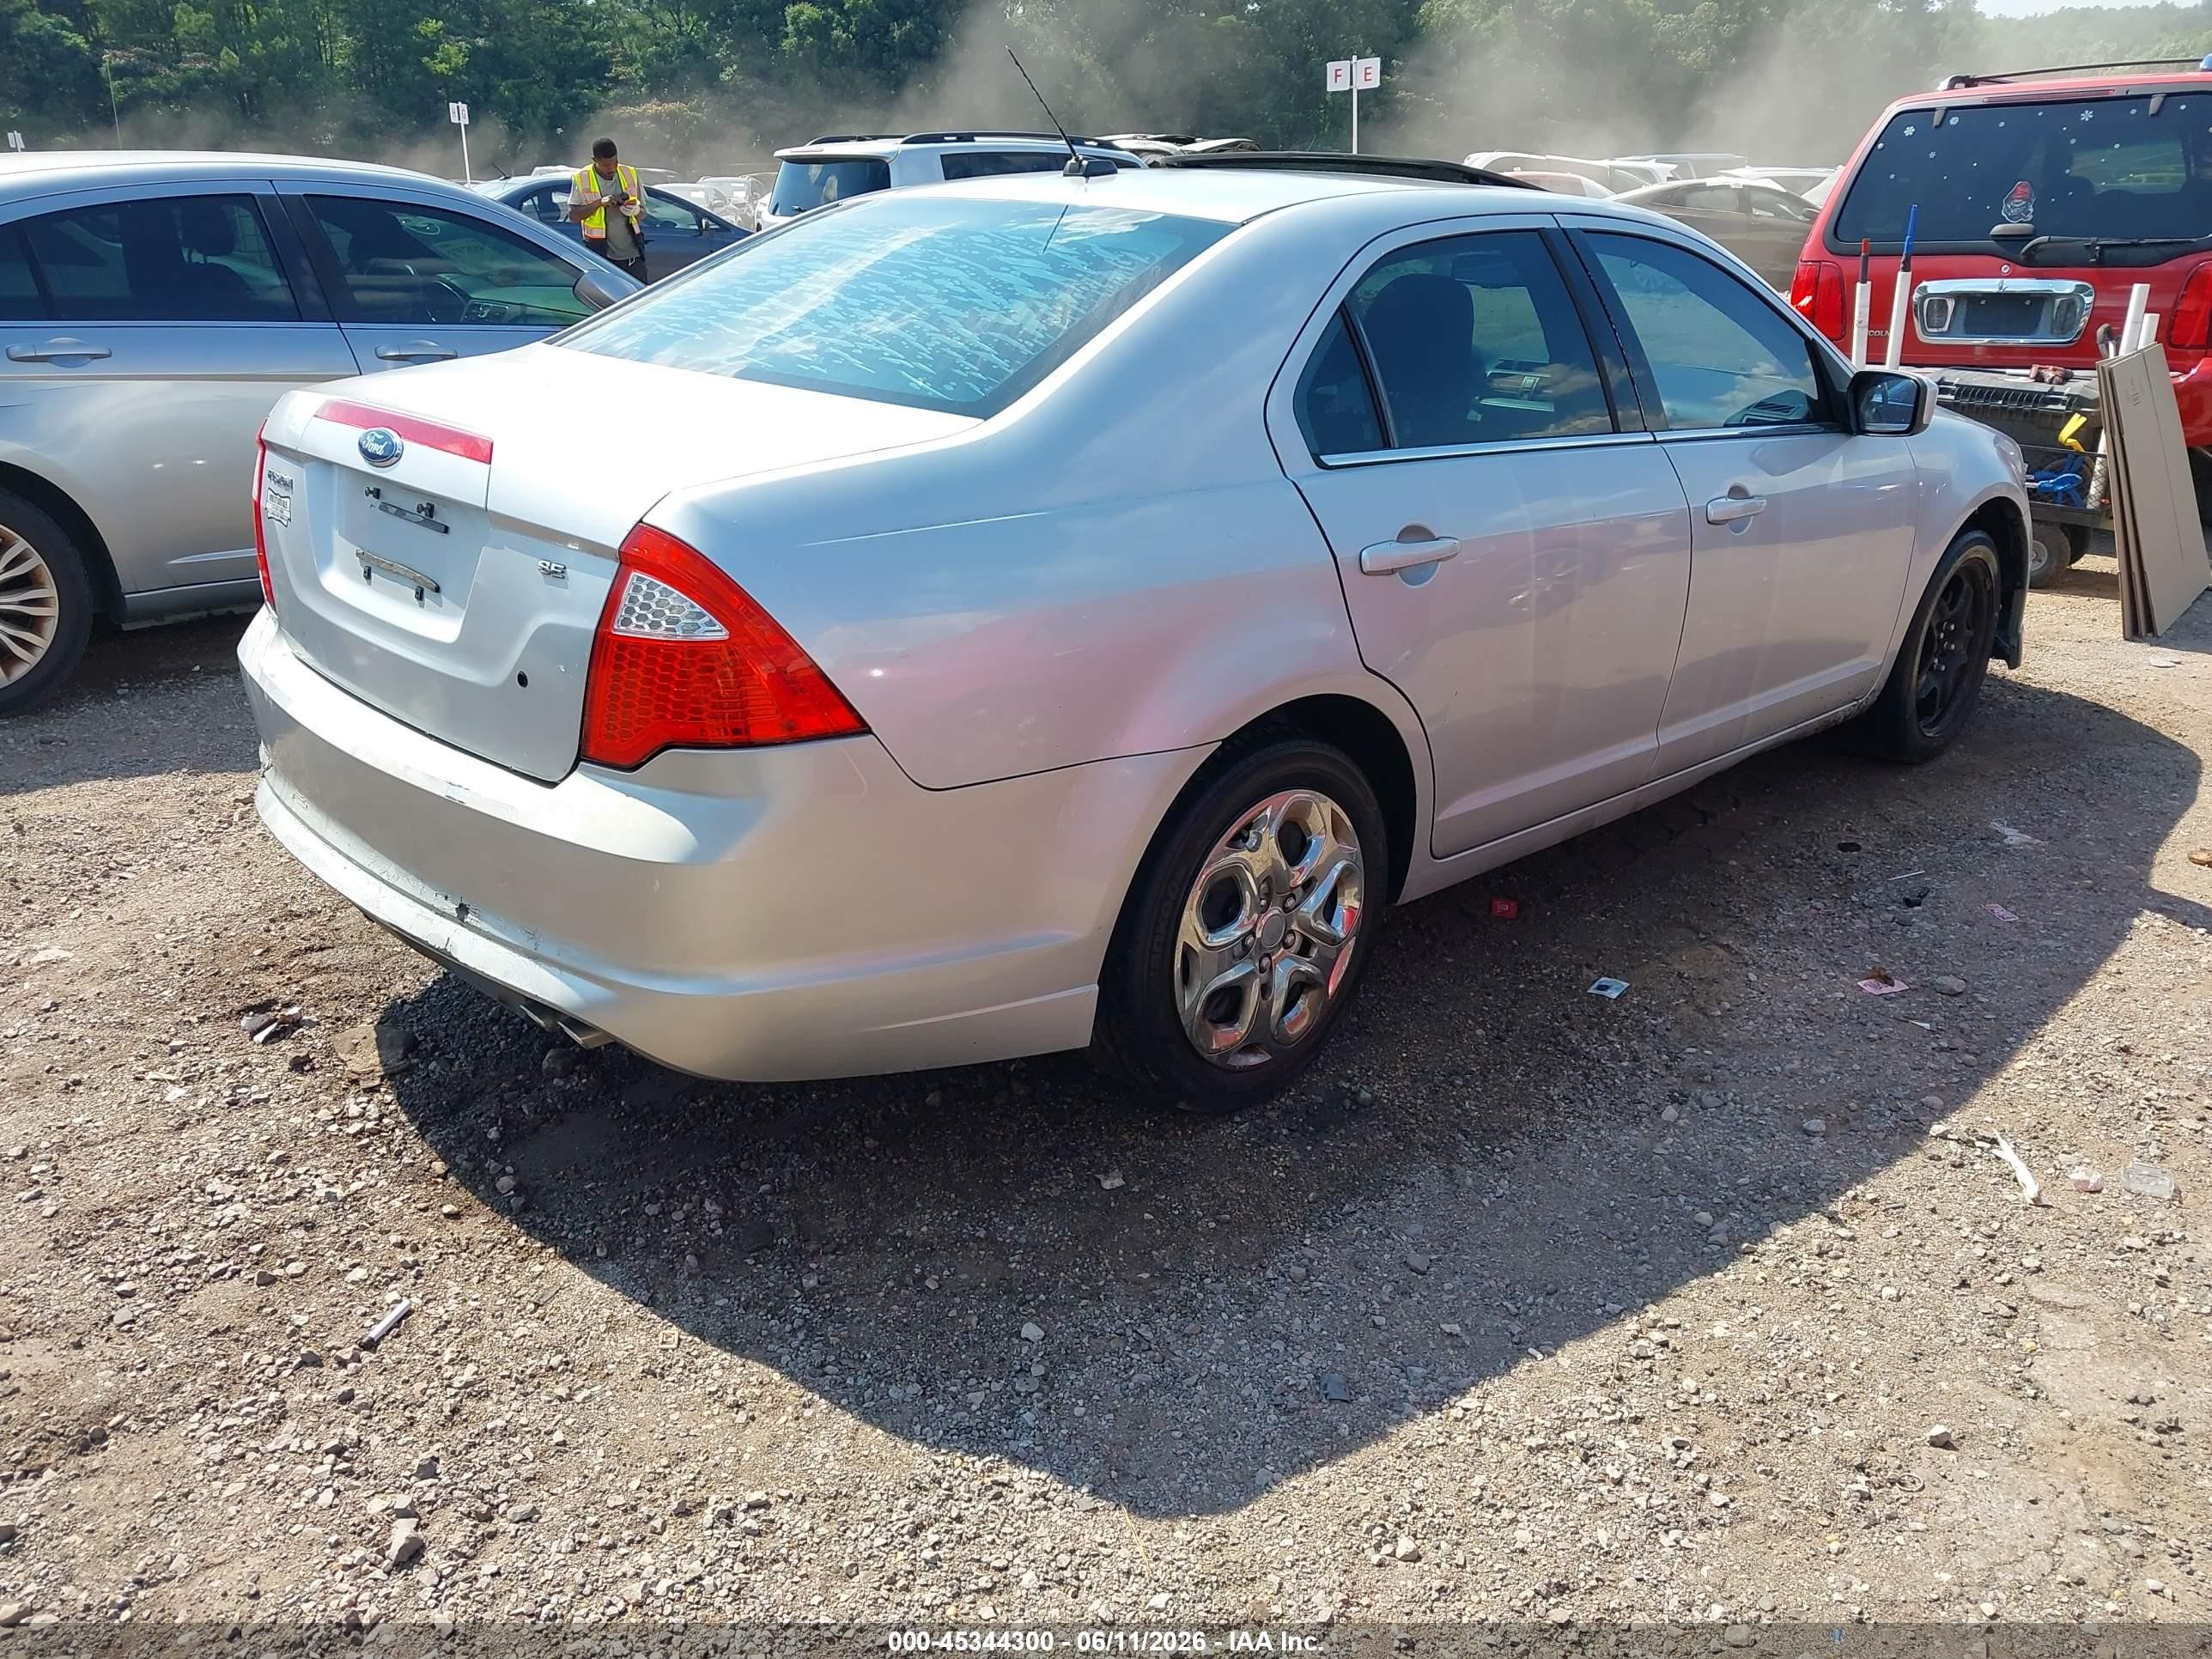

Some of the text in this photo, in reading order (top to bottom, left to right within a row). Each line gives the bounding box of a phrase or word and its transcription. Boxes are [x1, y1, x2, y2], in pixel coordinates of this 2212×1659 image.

[1334, 68, 1342, 83] F
[1364, 66, 1372, 82] E
[362, 431, 388, 456] Ford
[538, 559, 567, 580] SE
